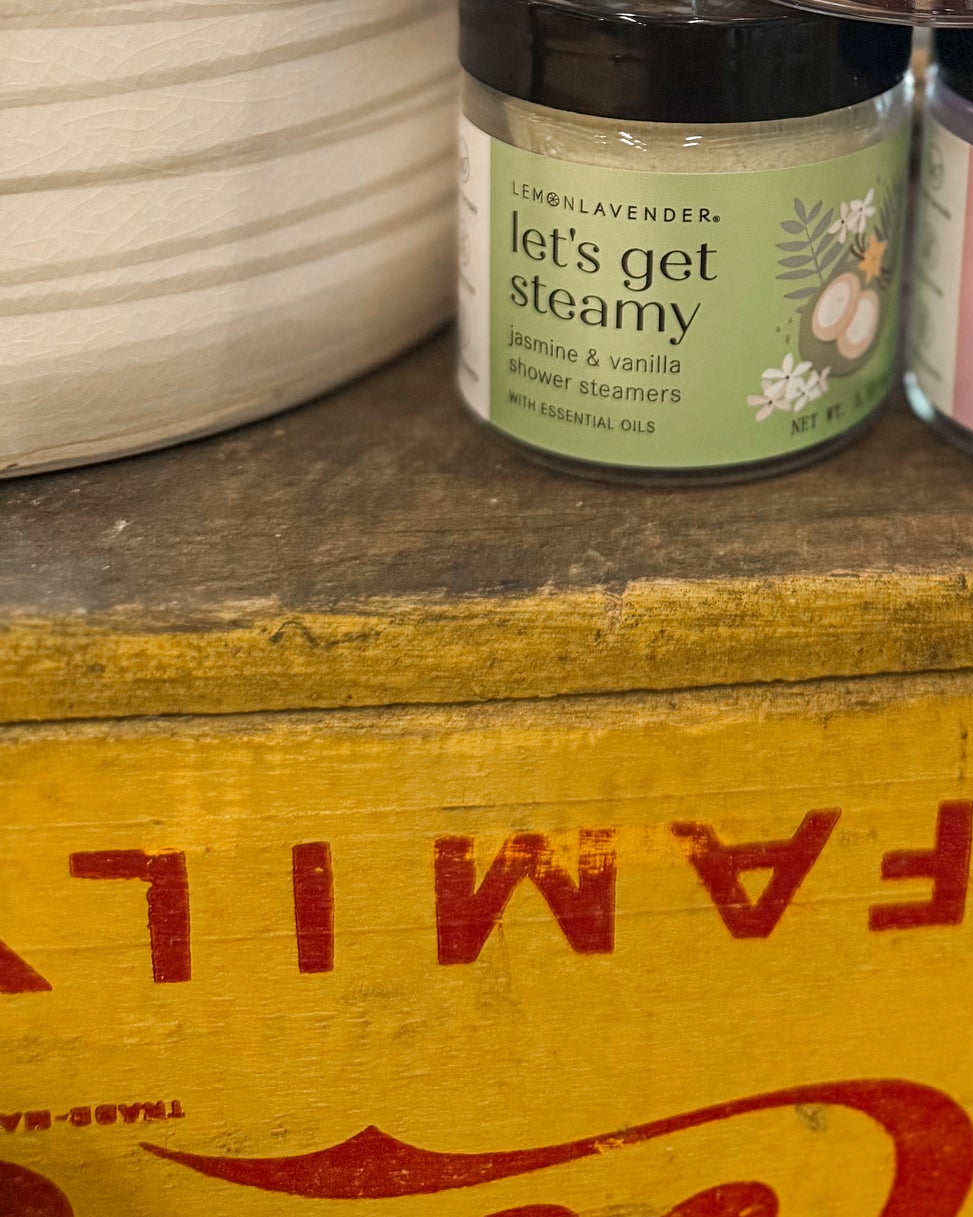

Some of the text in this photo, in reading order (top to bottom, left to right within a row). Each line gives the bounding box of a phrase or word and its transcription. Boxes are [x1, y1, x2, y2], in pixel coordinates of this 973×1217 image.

[511, 210, 718, 292] let's get
[510, 273, 701, 346] steamy
[509, 325, 681, 374] jasmine & vanilla
[509, 357, 573, 391] shower
[579, 378, 681, 403] steamers
[508, 390, 655, 434] WITH ESSENTIAL OILS
[791, 412, 818, 436] NET
